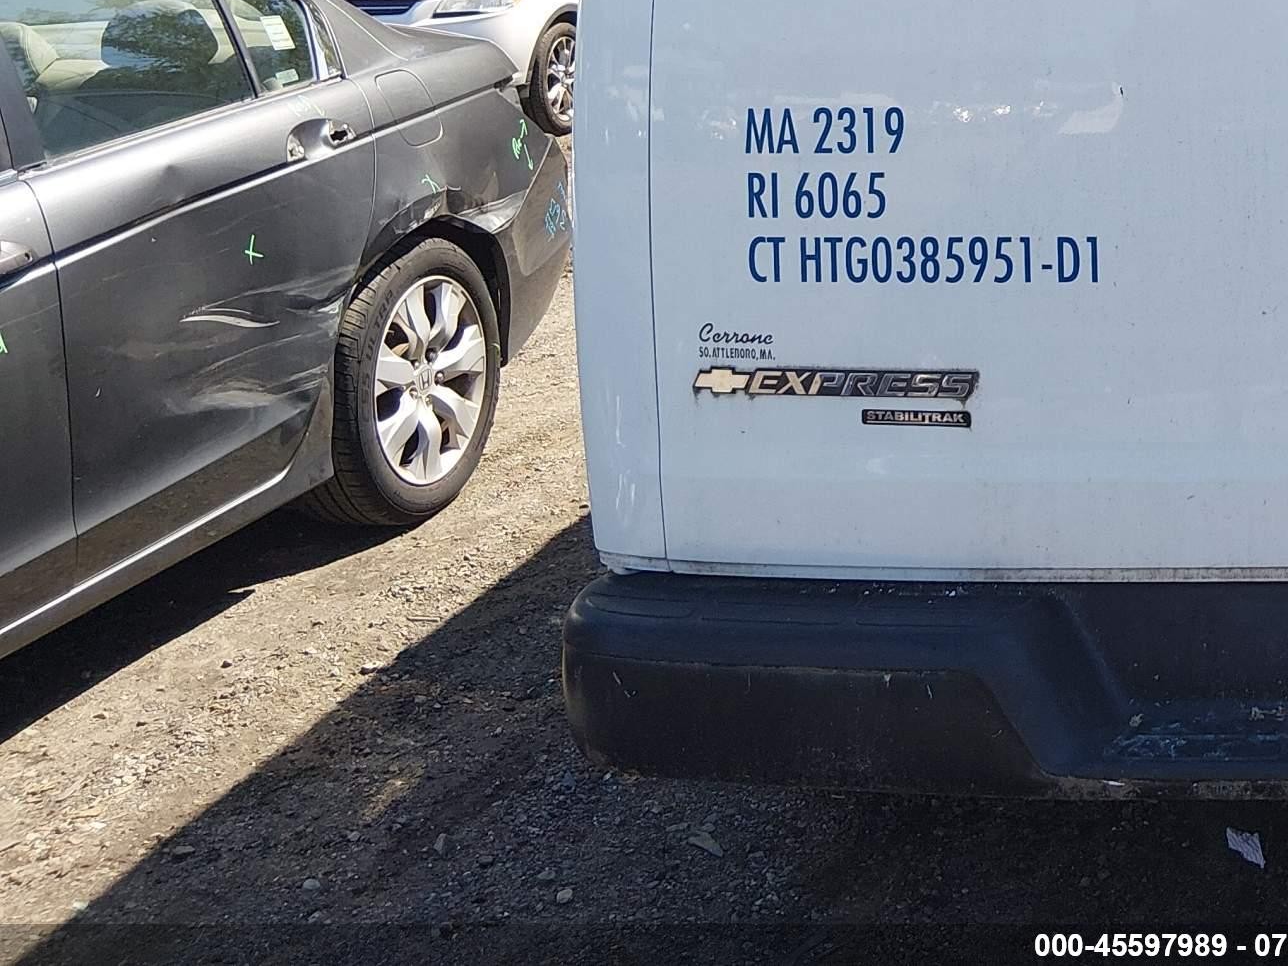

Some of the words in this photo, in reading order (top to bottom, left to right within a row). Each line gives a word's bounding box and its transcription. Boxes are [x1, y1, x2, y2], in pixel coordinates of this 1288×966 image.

[745, 108, 800, 154] MA
[813, 106, 904, 154] 2319
[748, 172, 778, 219] RI
[795, 171, 886, 219] 6065
[749, 236, 786, 283] CT
[800, 236, 1099, 284] HTG0385951-D1
[698, 322, 775, 345] Cerrone
[748, 370, 974, 398] EXPRESS
[866, 410, 966, 425] STABILITRAK
